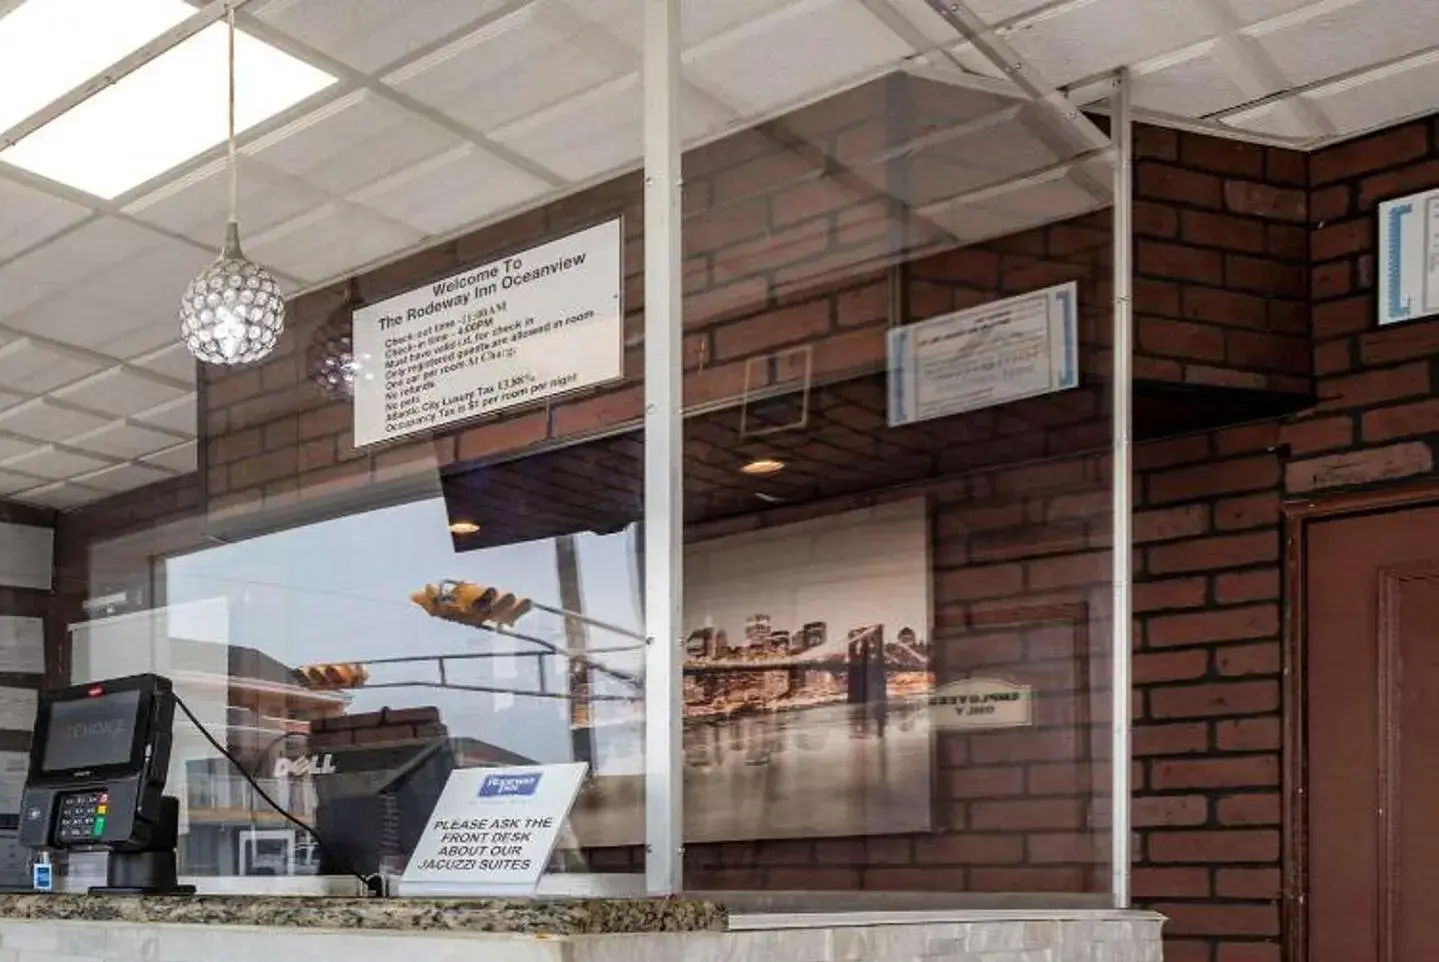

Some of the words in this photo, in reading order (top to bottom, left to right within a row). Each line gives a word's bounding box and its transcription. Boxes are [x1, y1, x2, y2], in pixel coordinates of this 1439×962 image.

[433, 267, 498, 296] Welcome
[503, 258, 522, 273] To
[379, 315, 403, 331] The
[407, 292, 470, 321] Rodeway
[475, 283, 497, 299] Inn
[502, 253, 586, 290] Oceanview
[478, 386, 494, 396] Tax
[273, 753, 336, 777] DELL
[433, 820, 488, 831] PLEASE
[489, 819, 521, 830] ASK
[523, 817, 552, 829] THE
[441, 832, 489, 843] FRONT
[490, 832, 532, 842] DESK
[438, 845, 488, 857] ABOUT
[490, 845, 522, 857] OUR
[417, 859, 476, 870] JACUZZI
[478, 859, 531, 870] SUITES
